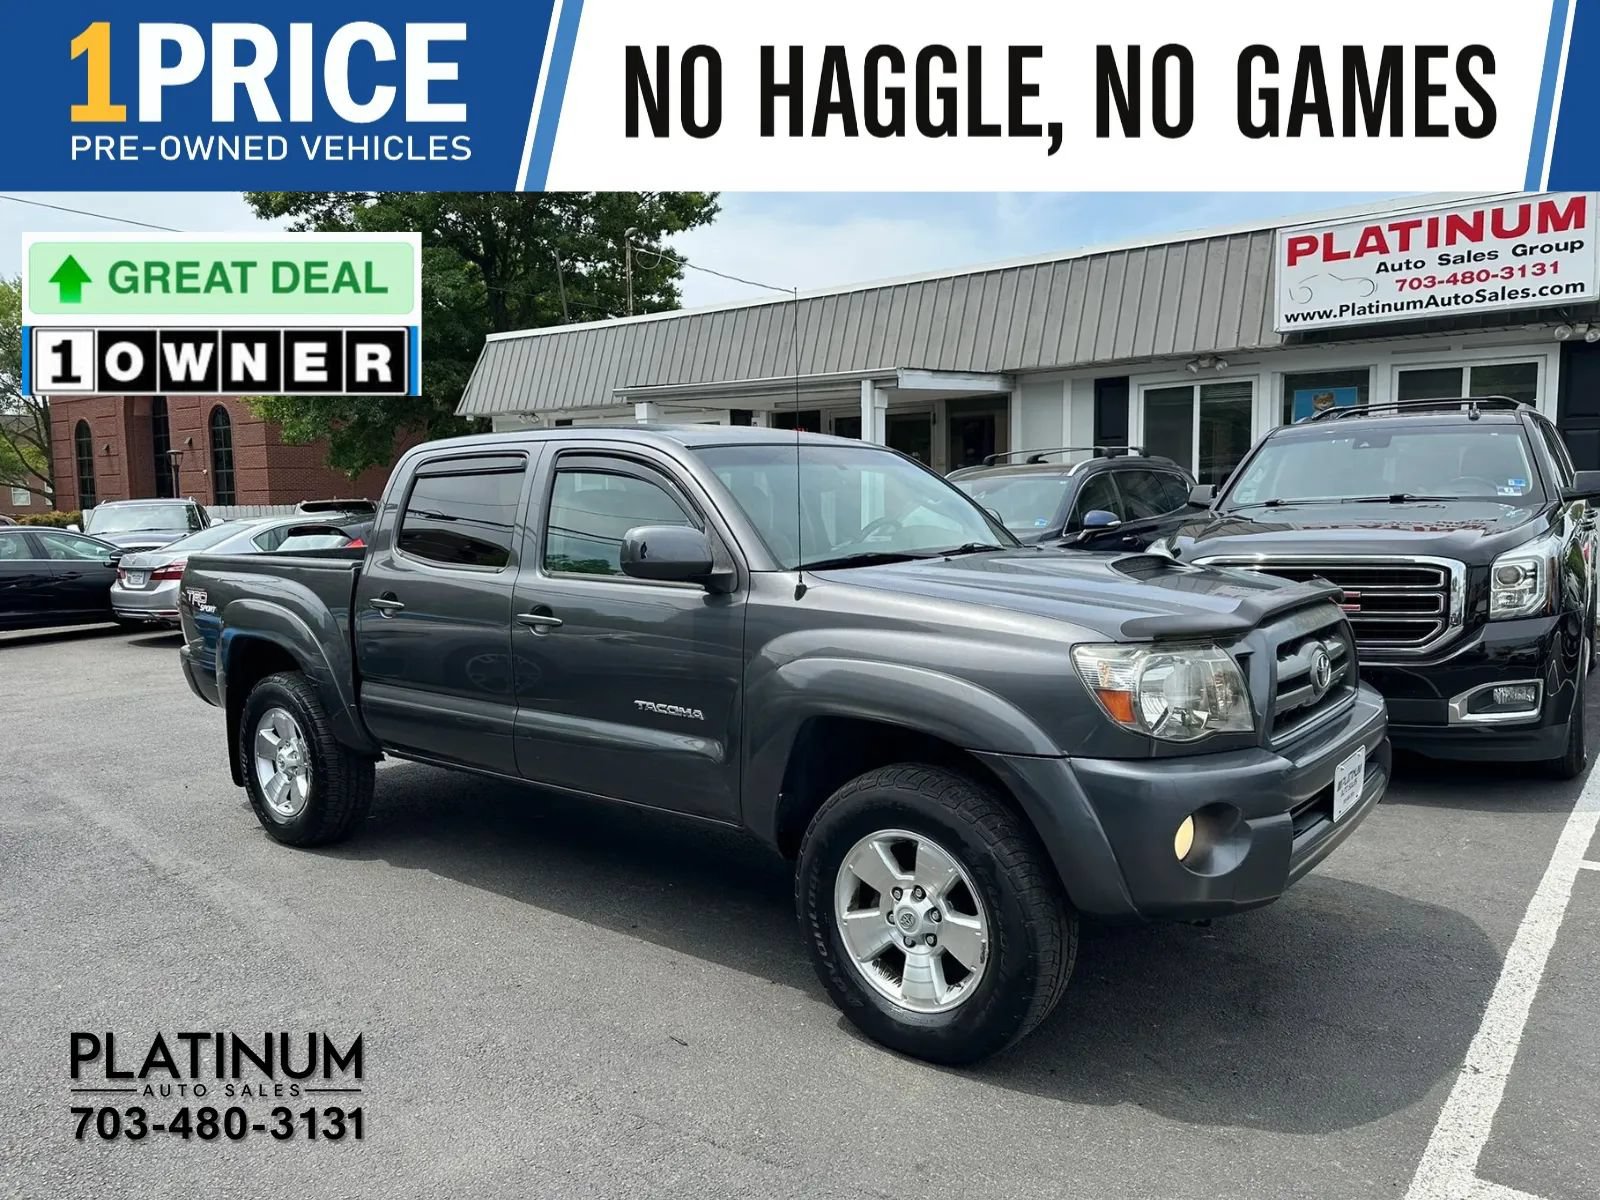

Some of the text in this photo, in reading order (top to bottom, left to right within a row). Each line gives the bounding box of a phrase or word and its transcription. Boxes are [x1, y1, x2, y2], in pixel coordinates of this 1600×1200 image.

[1287, 196, 1587, 266] PLATINUM
[1376, 240, 1585, 274] Auto Sales Group
[1395, 260, 1559, 292] 703-480-3131
[1285, 281, 1585, 323] www.PlatinumAutoSales.com
[633, 699, 705, 721] TACOMA
